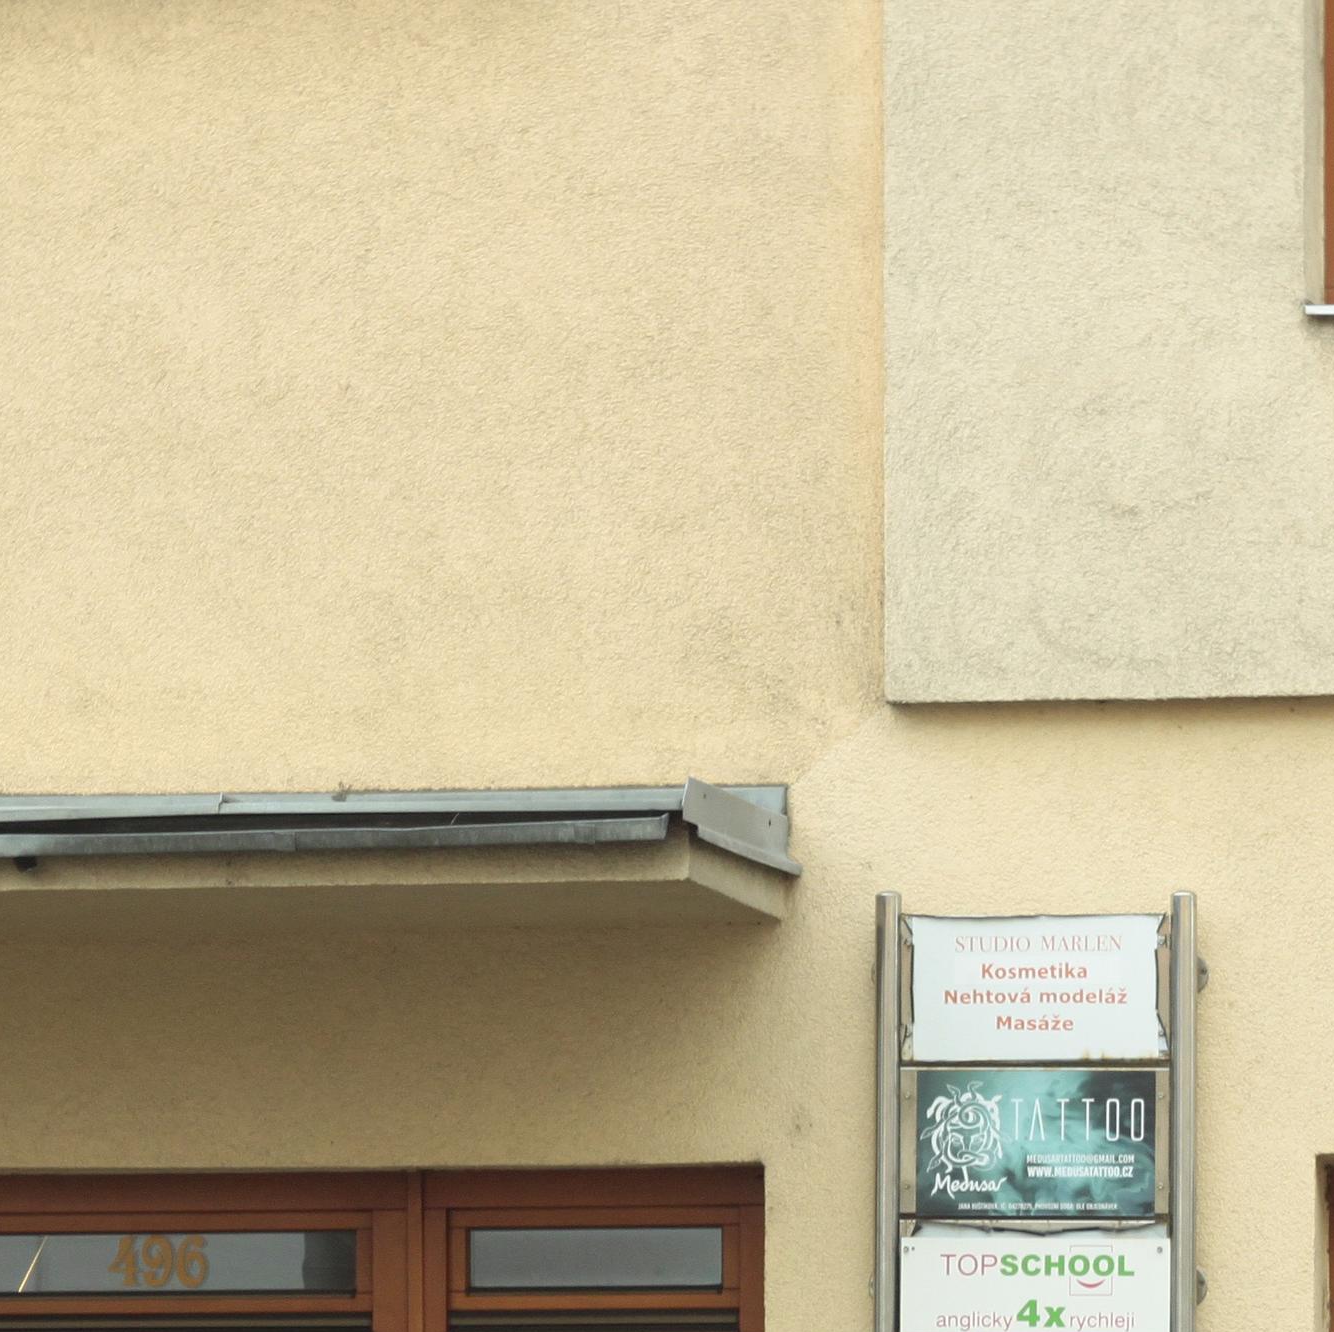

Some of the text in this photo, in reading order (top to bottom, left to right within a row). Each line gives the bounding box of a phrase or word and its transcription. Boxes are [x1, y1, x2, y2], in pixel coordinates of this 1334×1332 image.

[954, 934, 1123, 953] STUDIO MARLEN
[981, 962, 1088, 980] Kosmetika
[944, 986, 1128, 1005] Nehtová modeláž
[995, 1013, 1075, 1032] Masáže
[1010, 1097, 1146, 1143] TATTOO
[930, 1168, 1008, 1200] Medusa
[107, 1233, 209, 1288] 496
[940, 1254, 1135, 1277] TOPSCHOOL
[936, 1299, 1135, 1332] anglicky 4x rychleji
